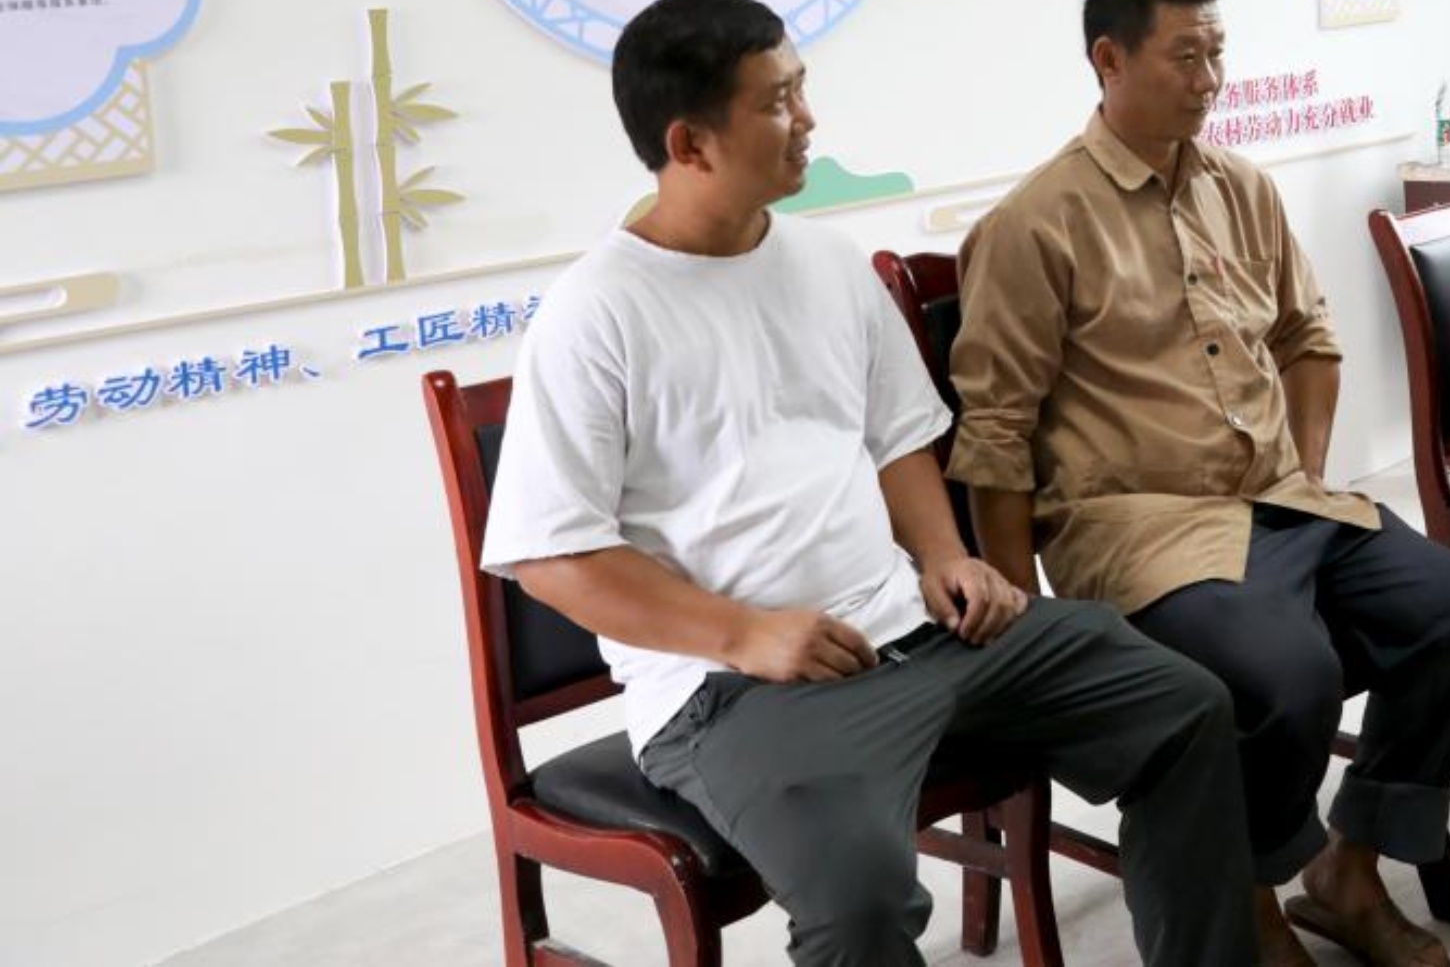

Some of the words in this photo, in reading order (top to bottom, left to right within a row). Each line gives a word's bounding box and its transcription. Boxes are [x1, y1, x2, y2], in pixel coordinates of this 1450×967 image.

[1211, 69, 1319, 113] 务服务体系
